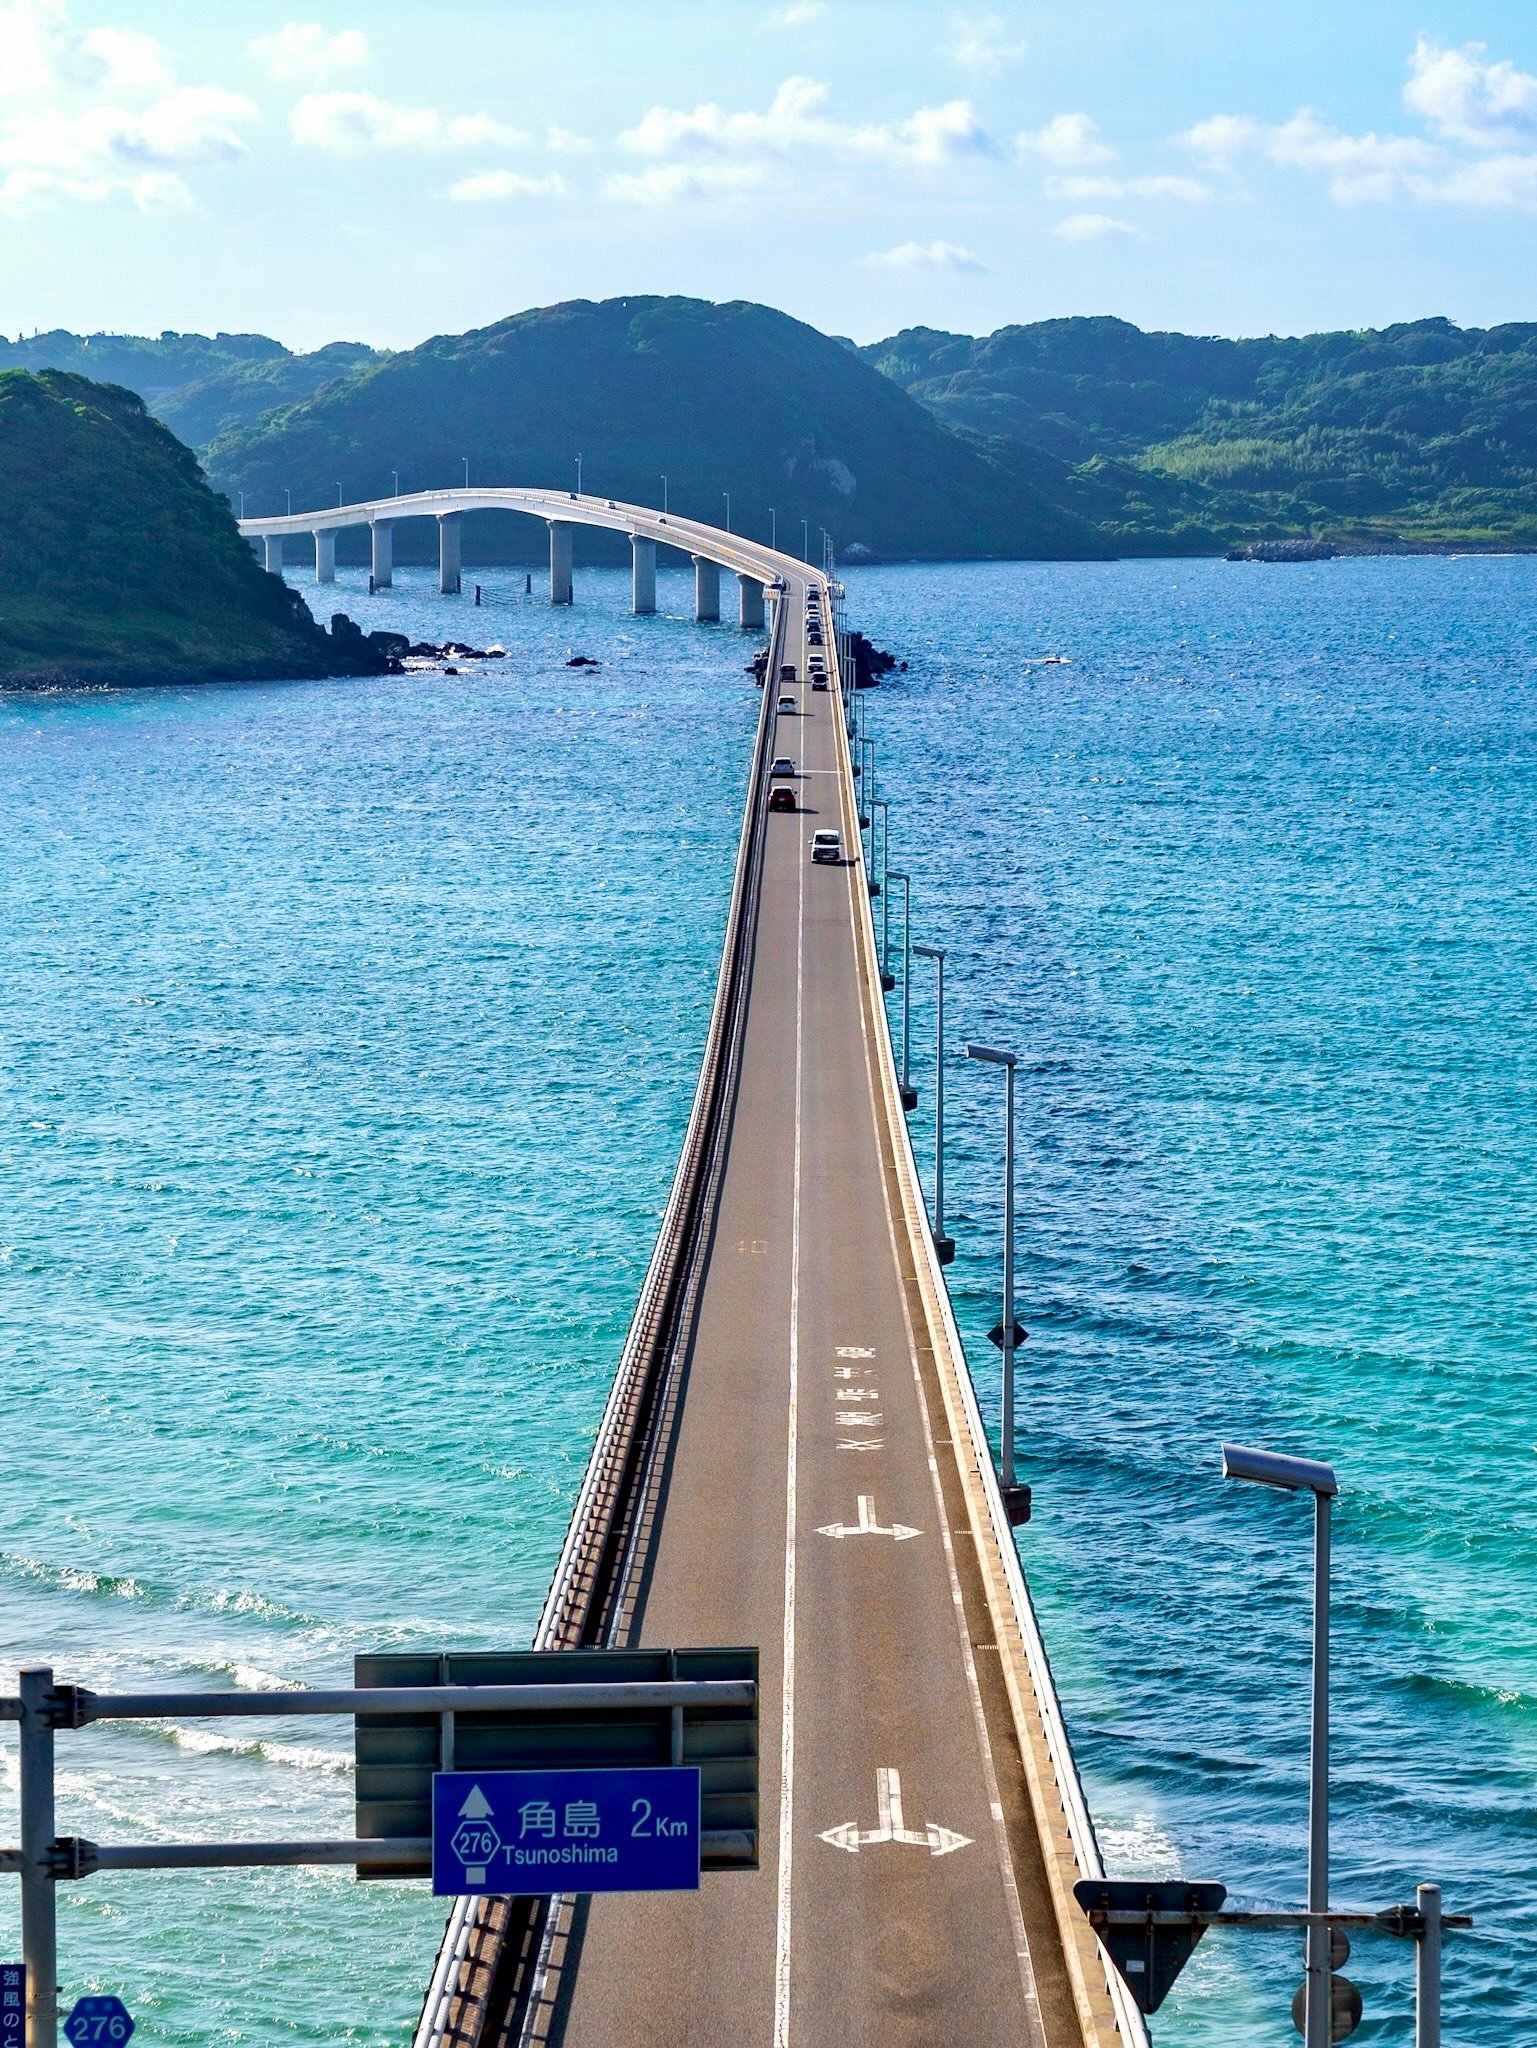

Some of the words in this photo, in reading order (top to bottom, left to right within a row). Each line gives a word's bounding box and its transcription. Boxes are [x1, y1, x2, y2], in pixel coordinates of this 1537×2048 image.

[518, 1800, 600, 1839] 角島
[459, 1832, 492, 1854] 276
[502, 1844, 618, 1865] Tsunoshima
[73, 2015, 126, 2041] 276
